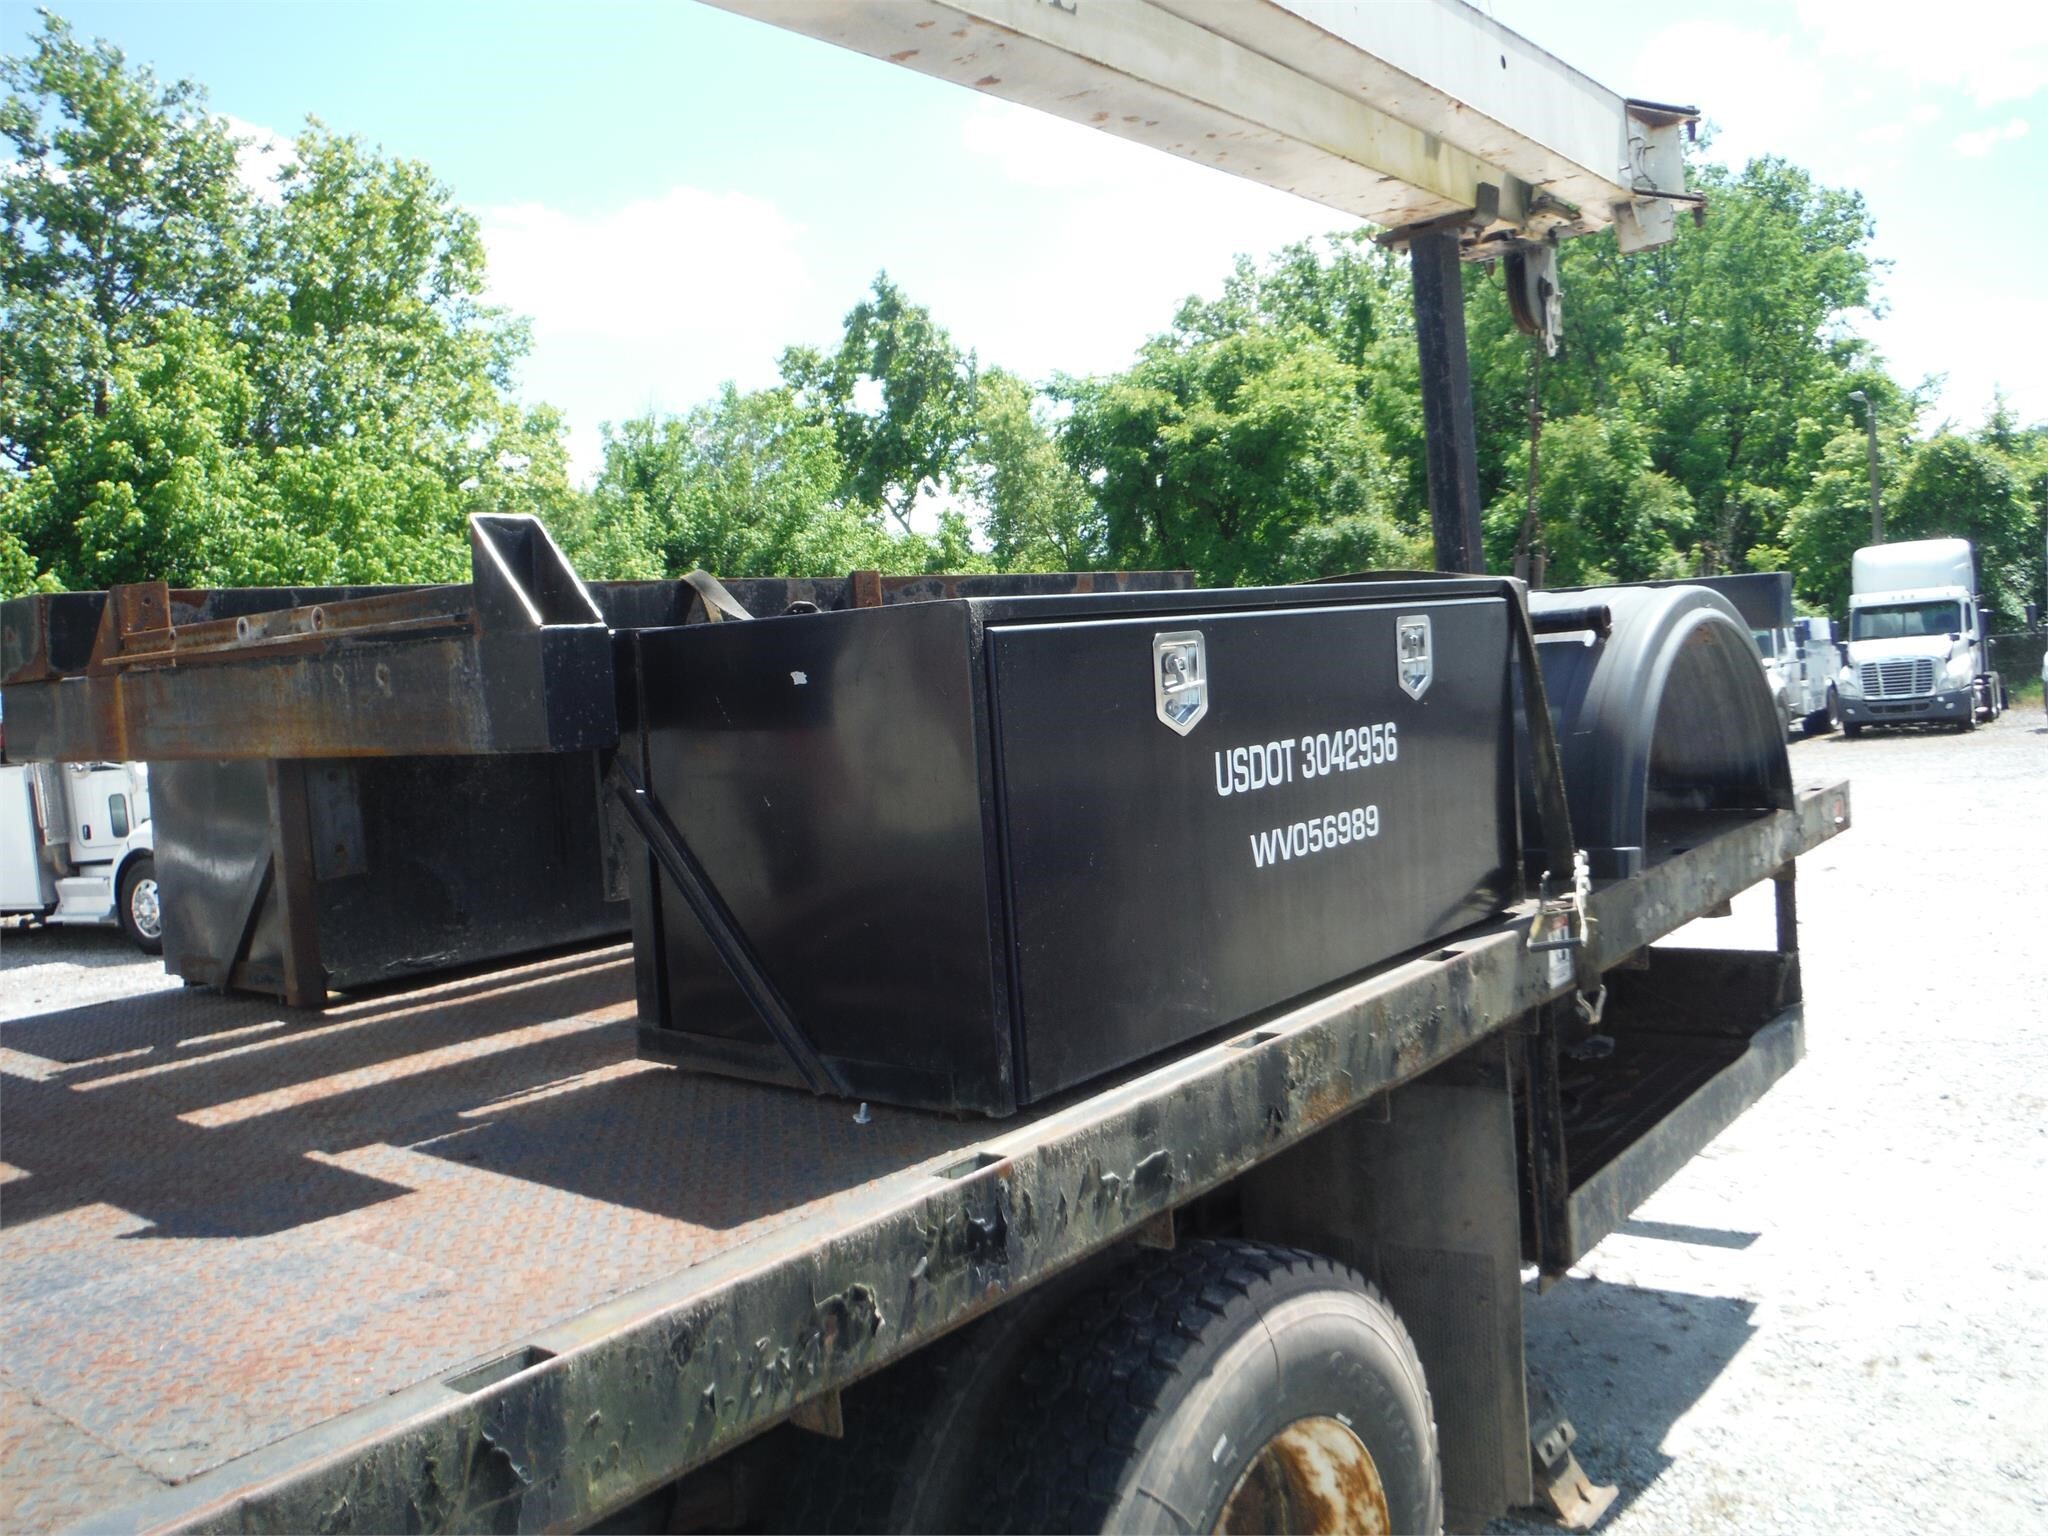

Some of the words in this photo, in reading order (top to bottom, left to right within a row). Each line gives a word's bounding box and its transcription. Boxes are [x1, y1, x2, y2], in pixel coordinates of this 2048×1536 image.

[1215, 738, 1296, 796] USDOT
[1301, 721, 1398, 779] 3042956
[1250, 804, 1379, 868] WV056989
